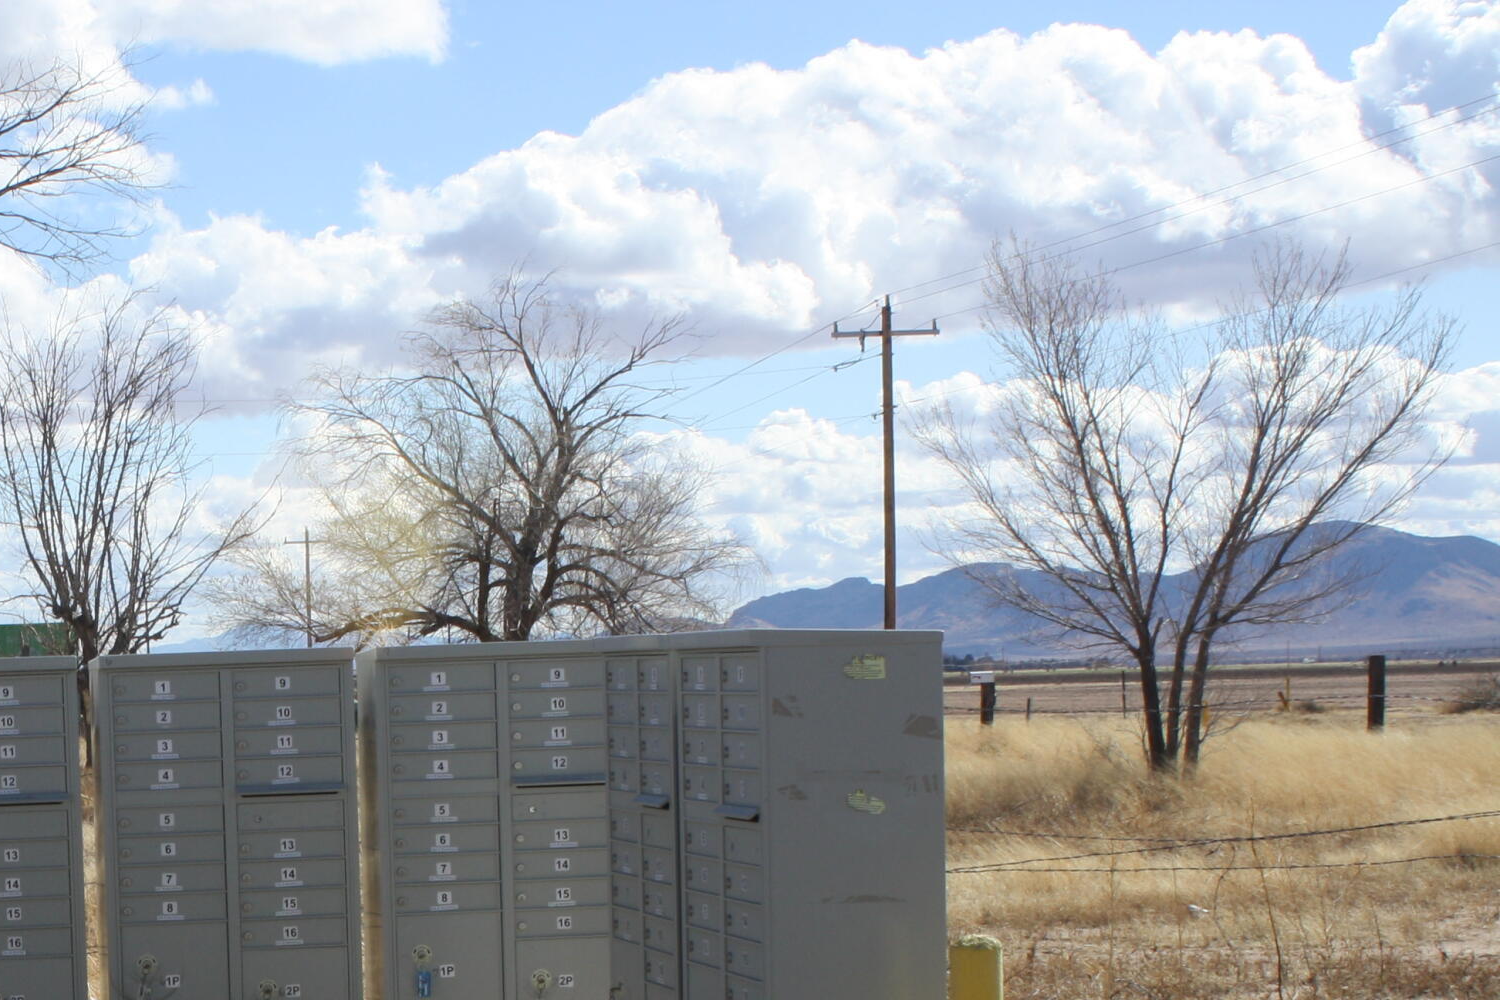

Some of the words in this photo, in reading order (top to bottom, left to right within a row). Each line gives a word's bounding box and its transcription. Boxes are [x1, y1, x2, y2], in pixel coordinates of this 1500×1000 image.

[553, 699, 565, 709] 10
[278, 708, 290, 718] 10
[0, 716, 14, 727] 10
[554, 728, 565, 738] 11
[280, 737, 291, 747] 11
[3, 747, 14, 757] 11
[554, 758, 566, 768] 12
[280, 766, 292, 777] 12
[3, 776, 15, 787] 12
[556, 830, 568, 840] 13
[282, 840, 295, 850] 13
[5, 850, 19, 861] 13
[556, 860, 569, 869] 14
[283, 869, 295, 879] 14
[7, 879, 19, 889] 14
[557, 889, 570, 899] 15
[284, 898, 297, 909] 15
[8, 908, 21, 919] 15
[558, 918, 571, 927] 16
[285, 927, 297, 938] 16
[9, 938, 22, 948] 16
[441, 966, 455, 976] 1P
[167, 976, 180, 986] 1P
[559, 975, 573, 986] 2P
[286, 986, 300, 996] 2P
